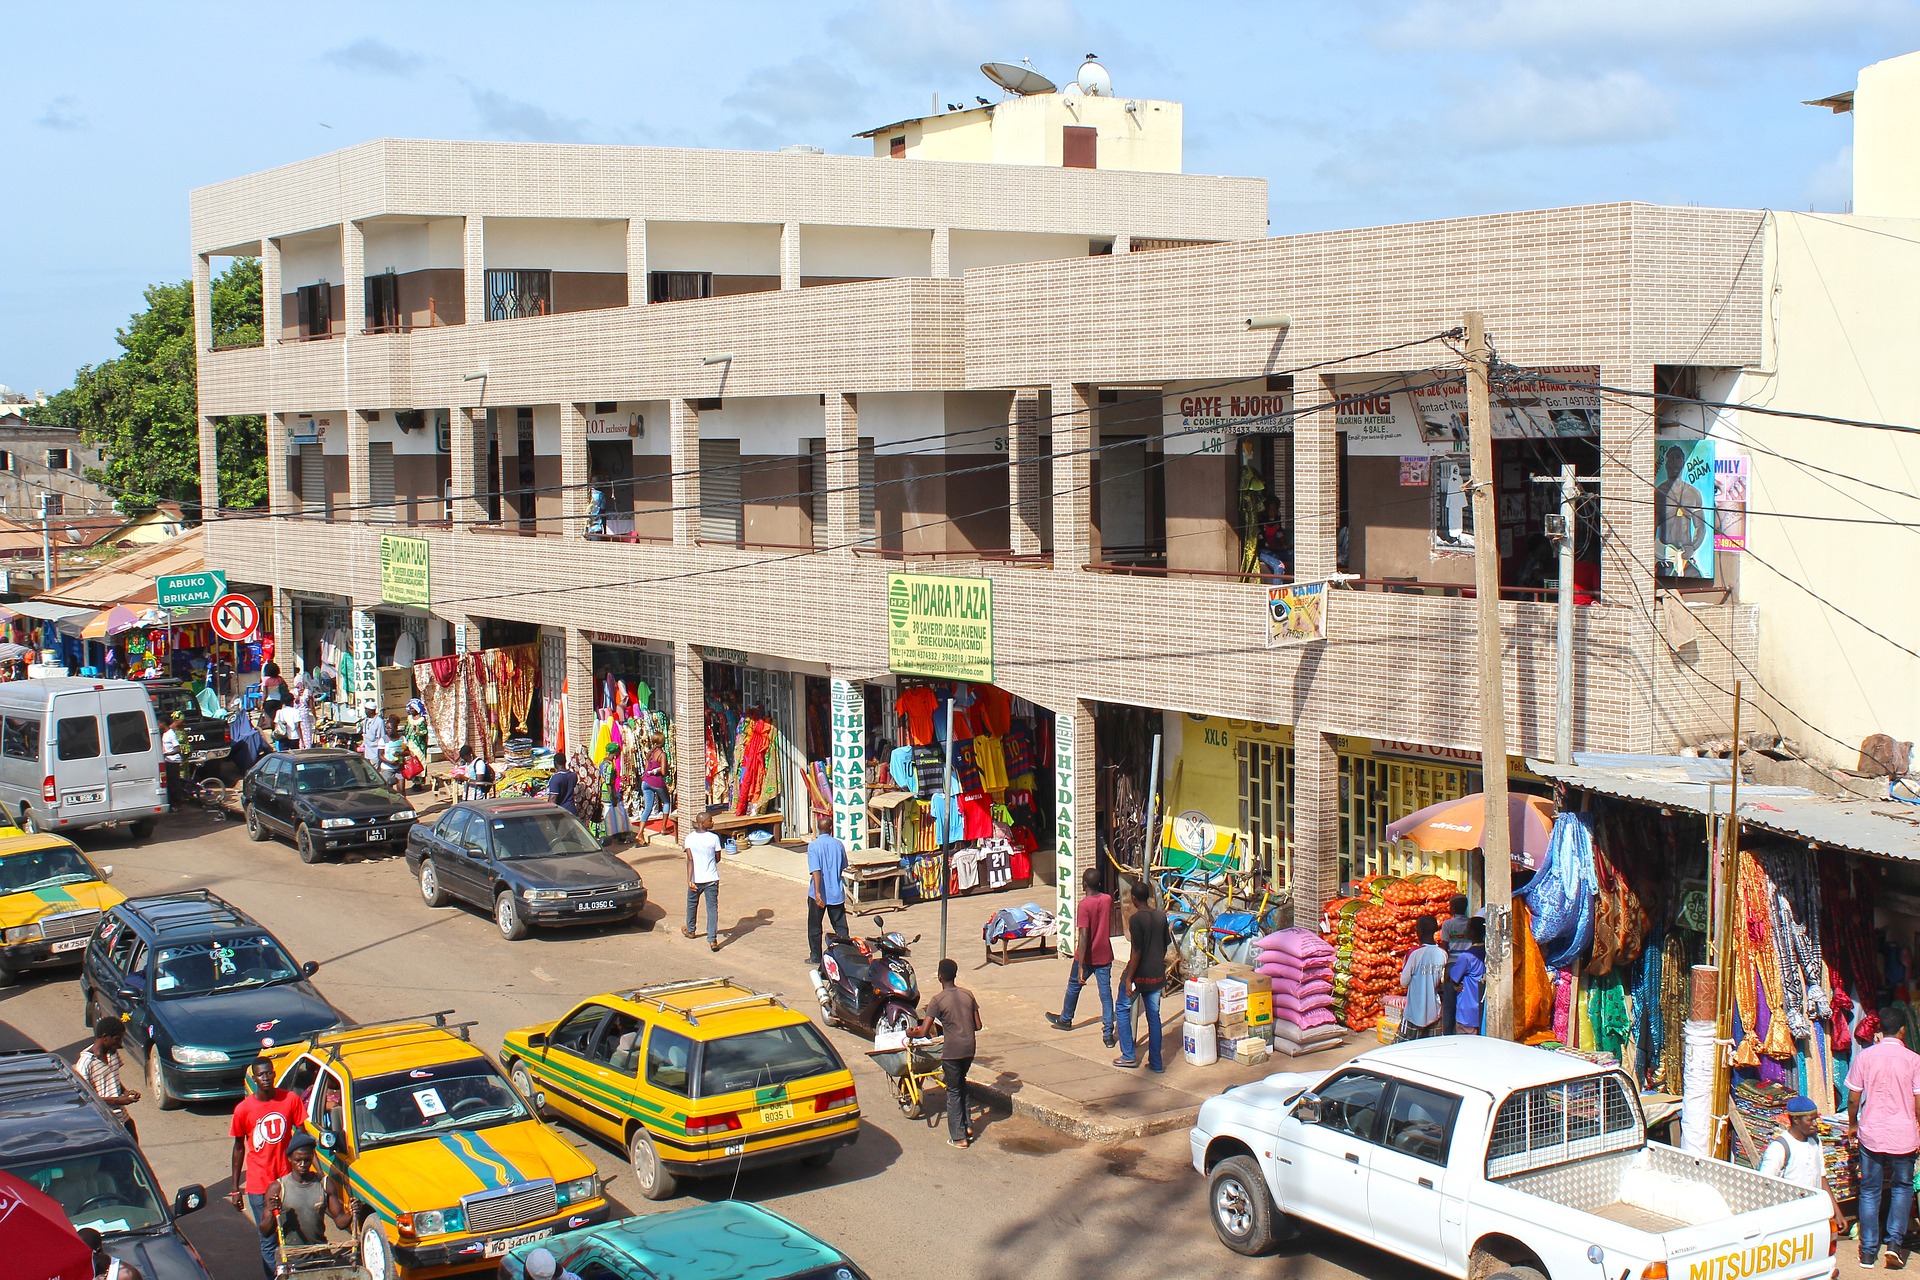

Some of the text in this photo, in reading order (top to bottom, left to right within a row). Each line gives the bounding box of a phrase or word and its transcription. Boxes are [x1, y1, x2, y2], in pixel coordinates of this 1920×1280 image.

[1180, 396, 1221, 417] GAYE
[1231, 396, 1283, 417] NJORO
[1364, 416, 1396, 424] MATERIALS
[606, 424, 628, 433] exclusive
[1211, 438, 1221, 453] 96
[1686, 456, 1704, 472] DAL
[1688, 463, 1711, 484] DIAM
[169, 578, 205, 588] ABUKO
[163, 591, 210, 603] BRIKAMA
[1269, 583, 1324, 601] VIP FAMILY
[891, 599, 909, 607] HPZ
[911, 583, 987, 620] HYDARA PLAZA
[912, 621, 919, 634] 39
[920, 622, 943, 636] SAYERR
[944, 624, 960, 637] JOBE
[960, 625, 986, 640] AVENUE
[917, 635, 983, 653] SEREKUNDA(KSMD)
[362, 629, 375, 692] HYDARA
[1204, 728, 1228, 746] XXL 6
[1007, 741, 1020, 757] 10
[833, 714, 846, 806] HYDARA
[847, 714, 864, 806] HYDARA
[964, 751, 972, 766] 9
[1510, 761, 1522, 772] Tel:
[903, 762, 914, 778] 10
[1430, 821, 1472, 833] africell
[992, 852, 1005, 868] 21
[1057, 754, 1073, 954] HYDARA PLAZA
[765, 1110, 792, 1122] 8035 L
[264, 1118, 282, 1139] U
[1690, 1233, 1814, 1280] MITSUBISHI
